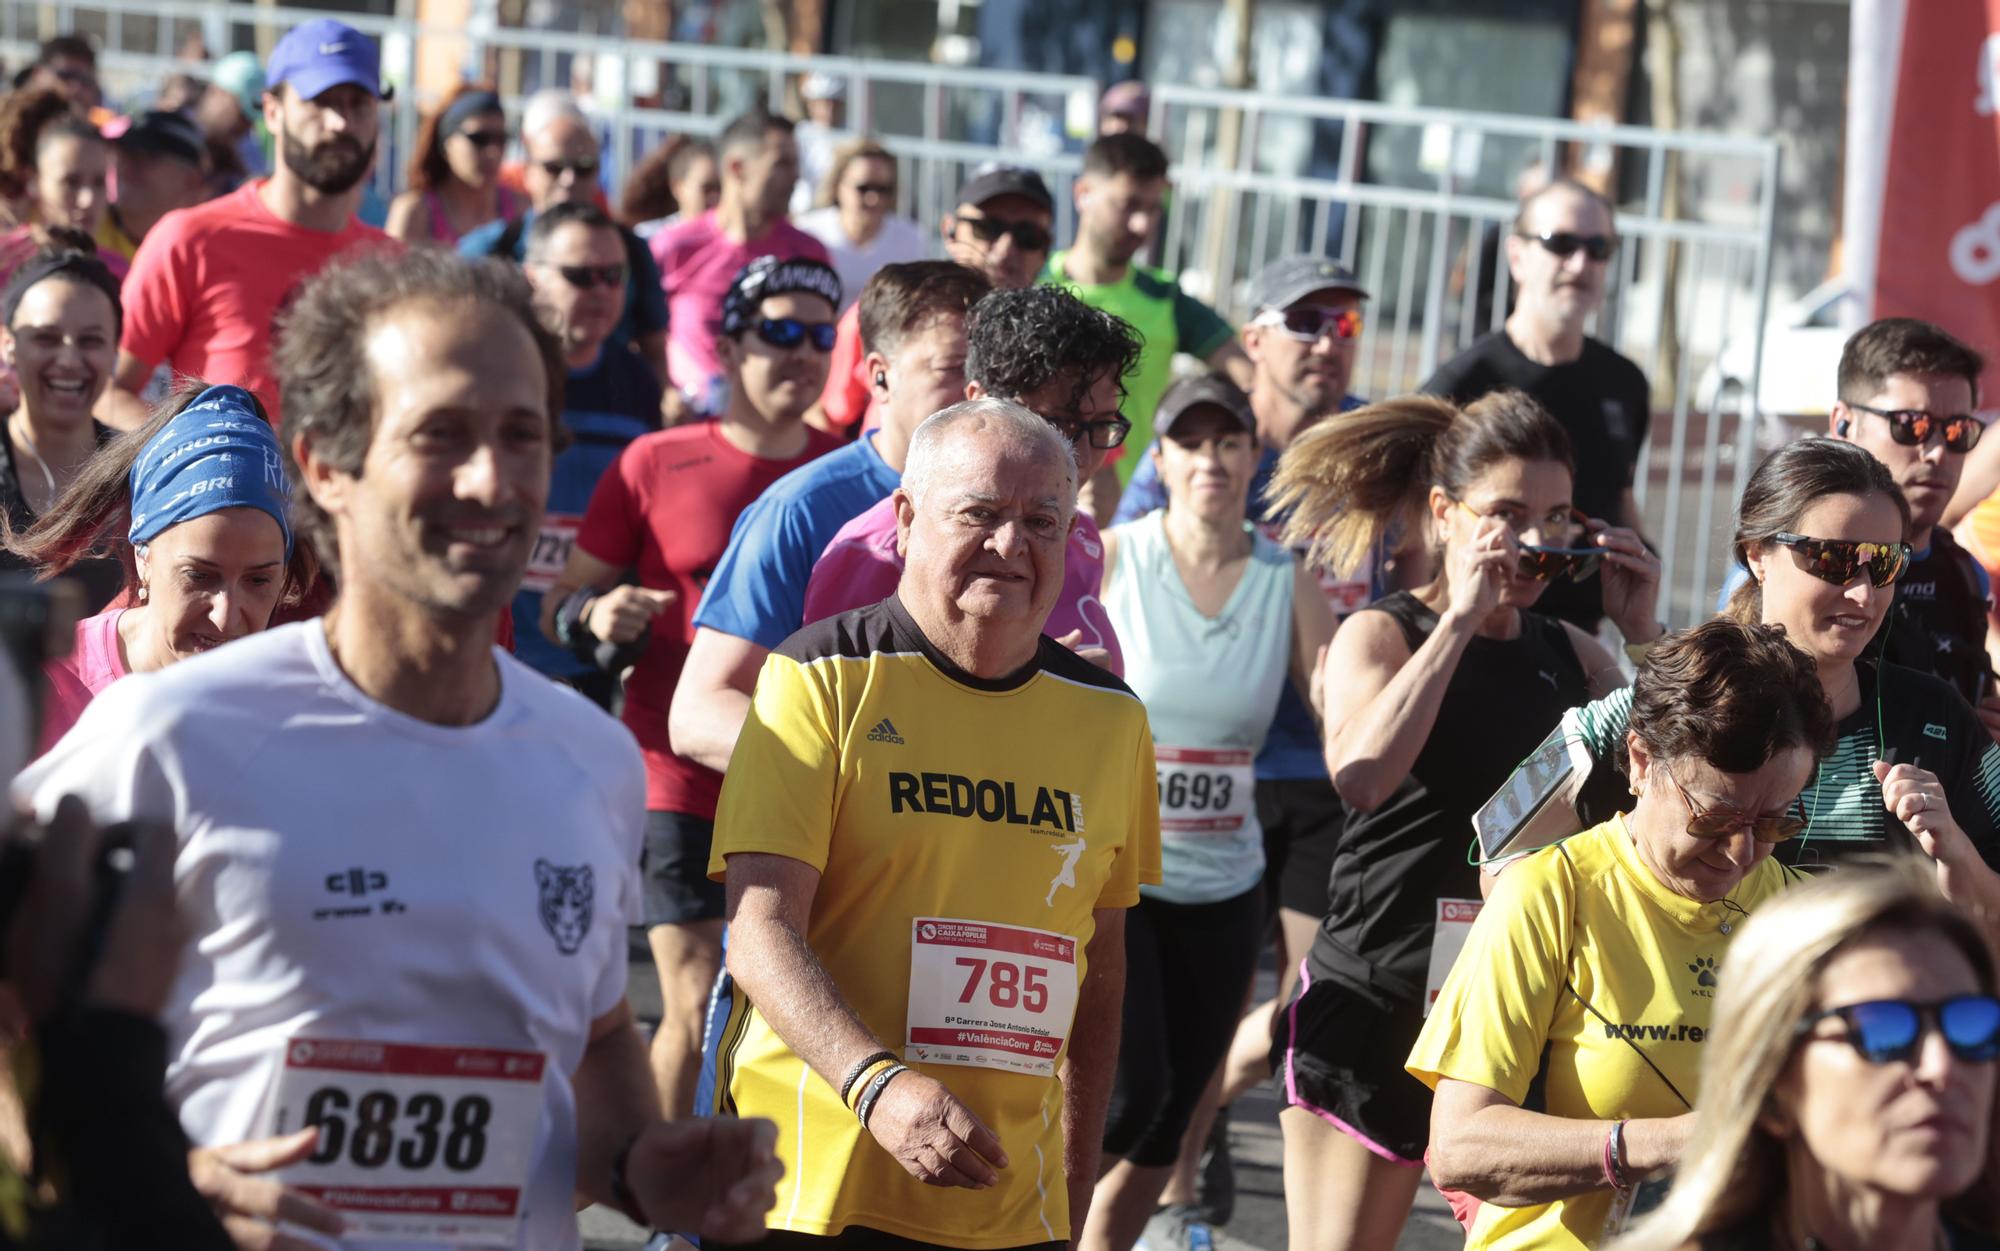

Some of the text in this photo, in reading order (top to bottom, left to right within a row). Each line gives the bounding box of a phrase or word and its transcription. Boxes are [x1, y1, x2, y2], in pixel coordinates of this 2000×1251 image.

[866, 733, 905, 745] adidas
[888, 771, 1076, 833] REDOLAT
[1157, 772, 1233, 811] 693
[1070, 792, 1086, 833] TEAM
[937, 929, 987, 940] CAIXA POPULAR
[955, 957, 1048, 1014] 785
[956, 1017, 989, 1028] Carrera
[989, 1020, 1007, 1030] Jose
[1007, 1023, 1031, 1034] Antonio
[1030, 1027, 1050, 1037] Redolat
[956, 1032, 1030, 1051] #ValènciaCorre
[304, 1086, 492, 1173] 6838
